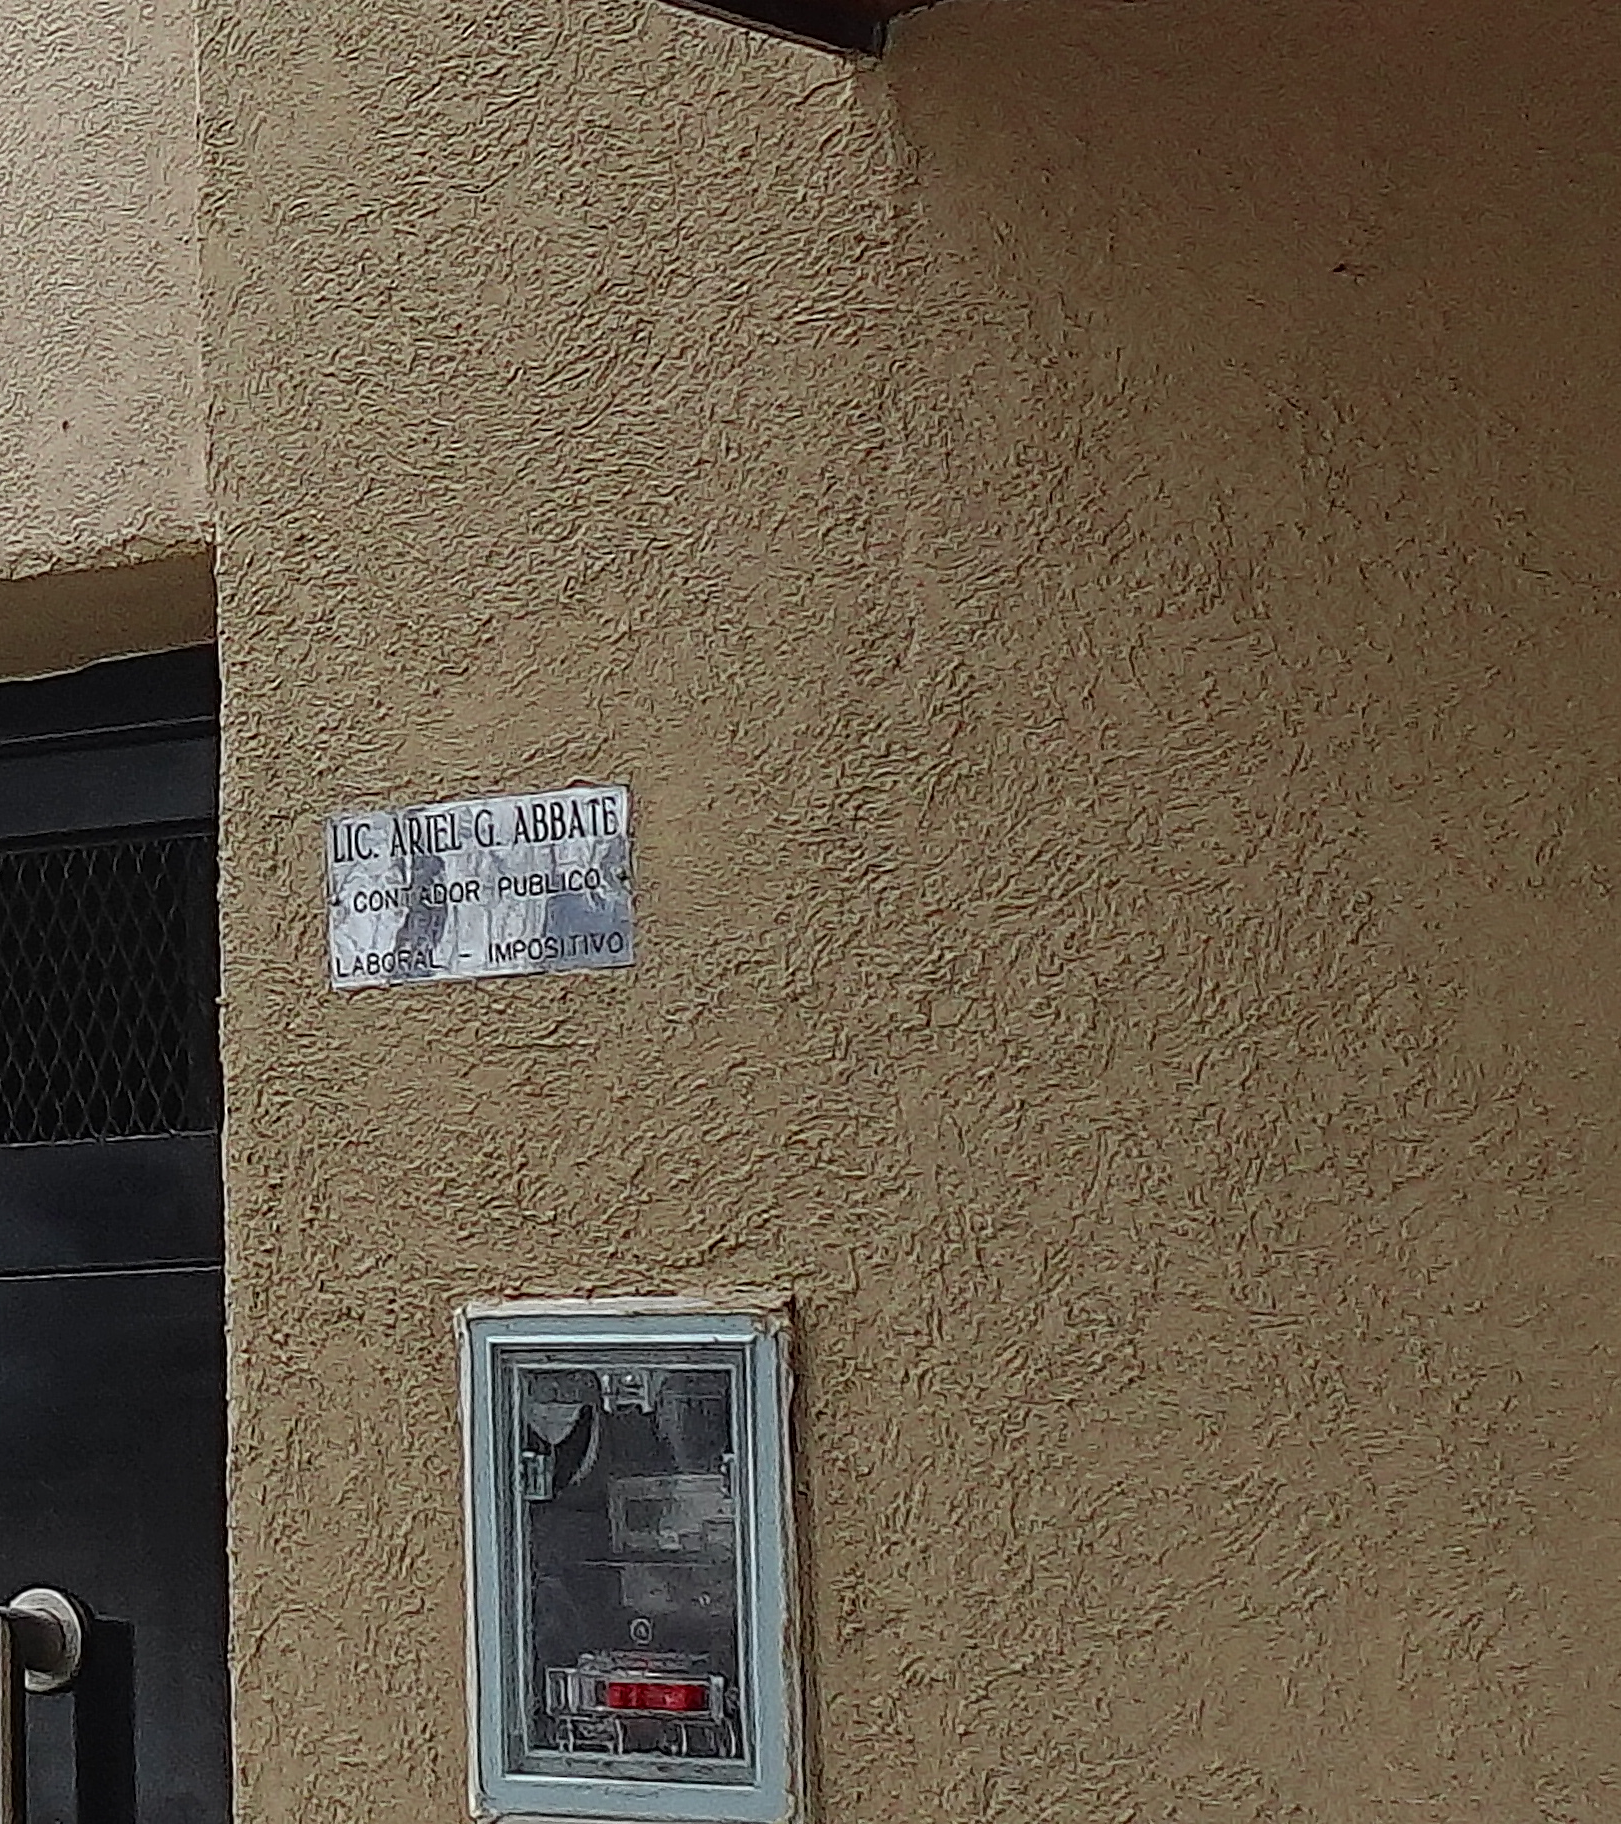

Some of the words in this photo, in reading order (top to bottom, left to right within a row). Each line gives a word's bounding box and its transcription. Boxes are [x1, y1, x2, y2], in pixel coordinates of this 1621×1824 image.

[332, 822, 380, 864] LIC.
[389, 812, 463, 857] ARIEL
[473, 808, 502, 848] G.
[513, 796, 619, 846] ABBATE
[352, 879, 481, 914] CONTADOR
[497, 867, 601, 899] PUBLICO
[334, 947, 446, 978] LABORAL
[488, 931, 625, 964] IMPOSITIVO
